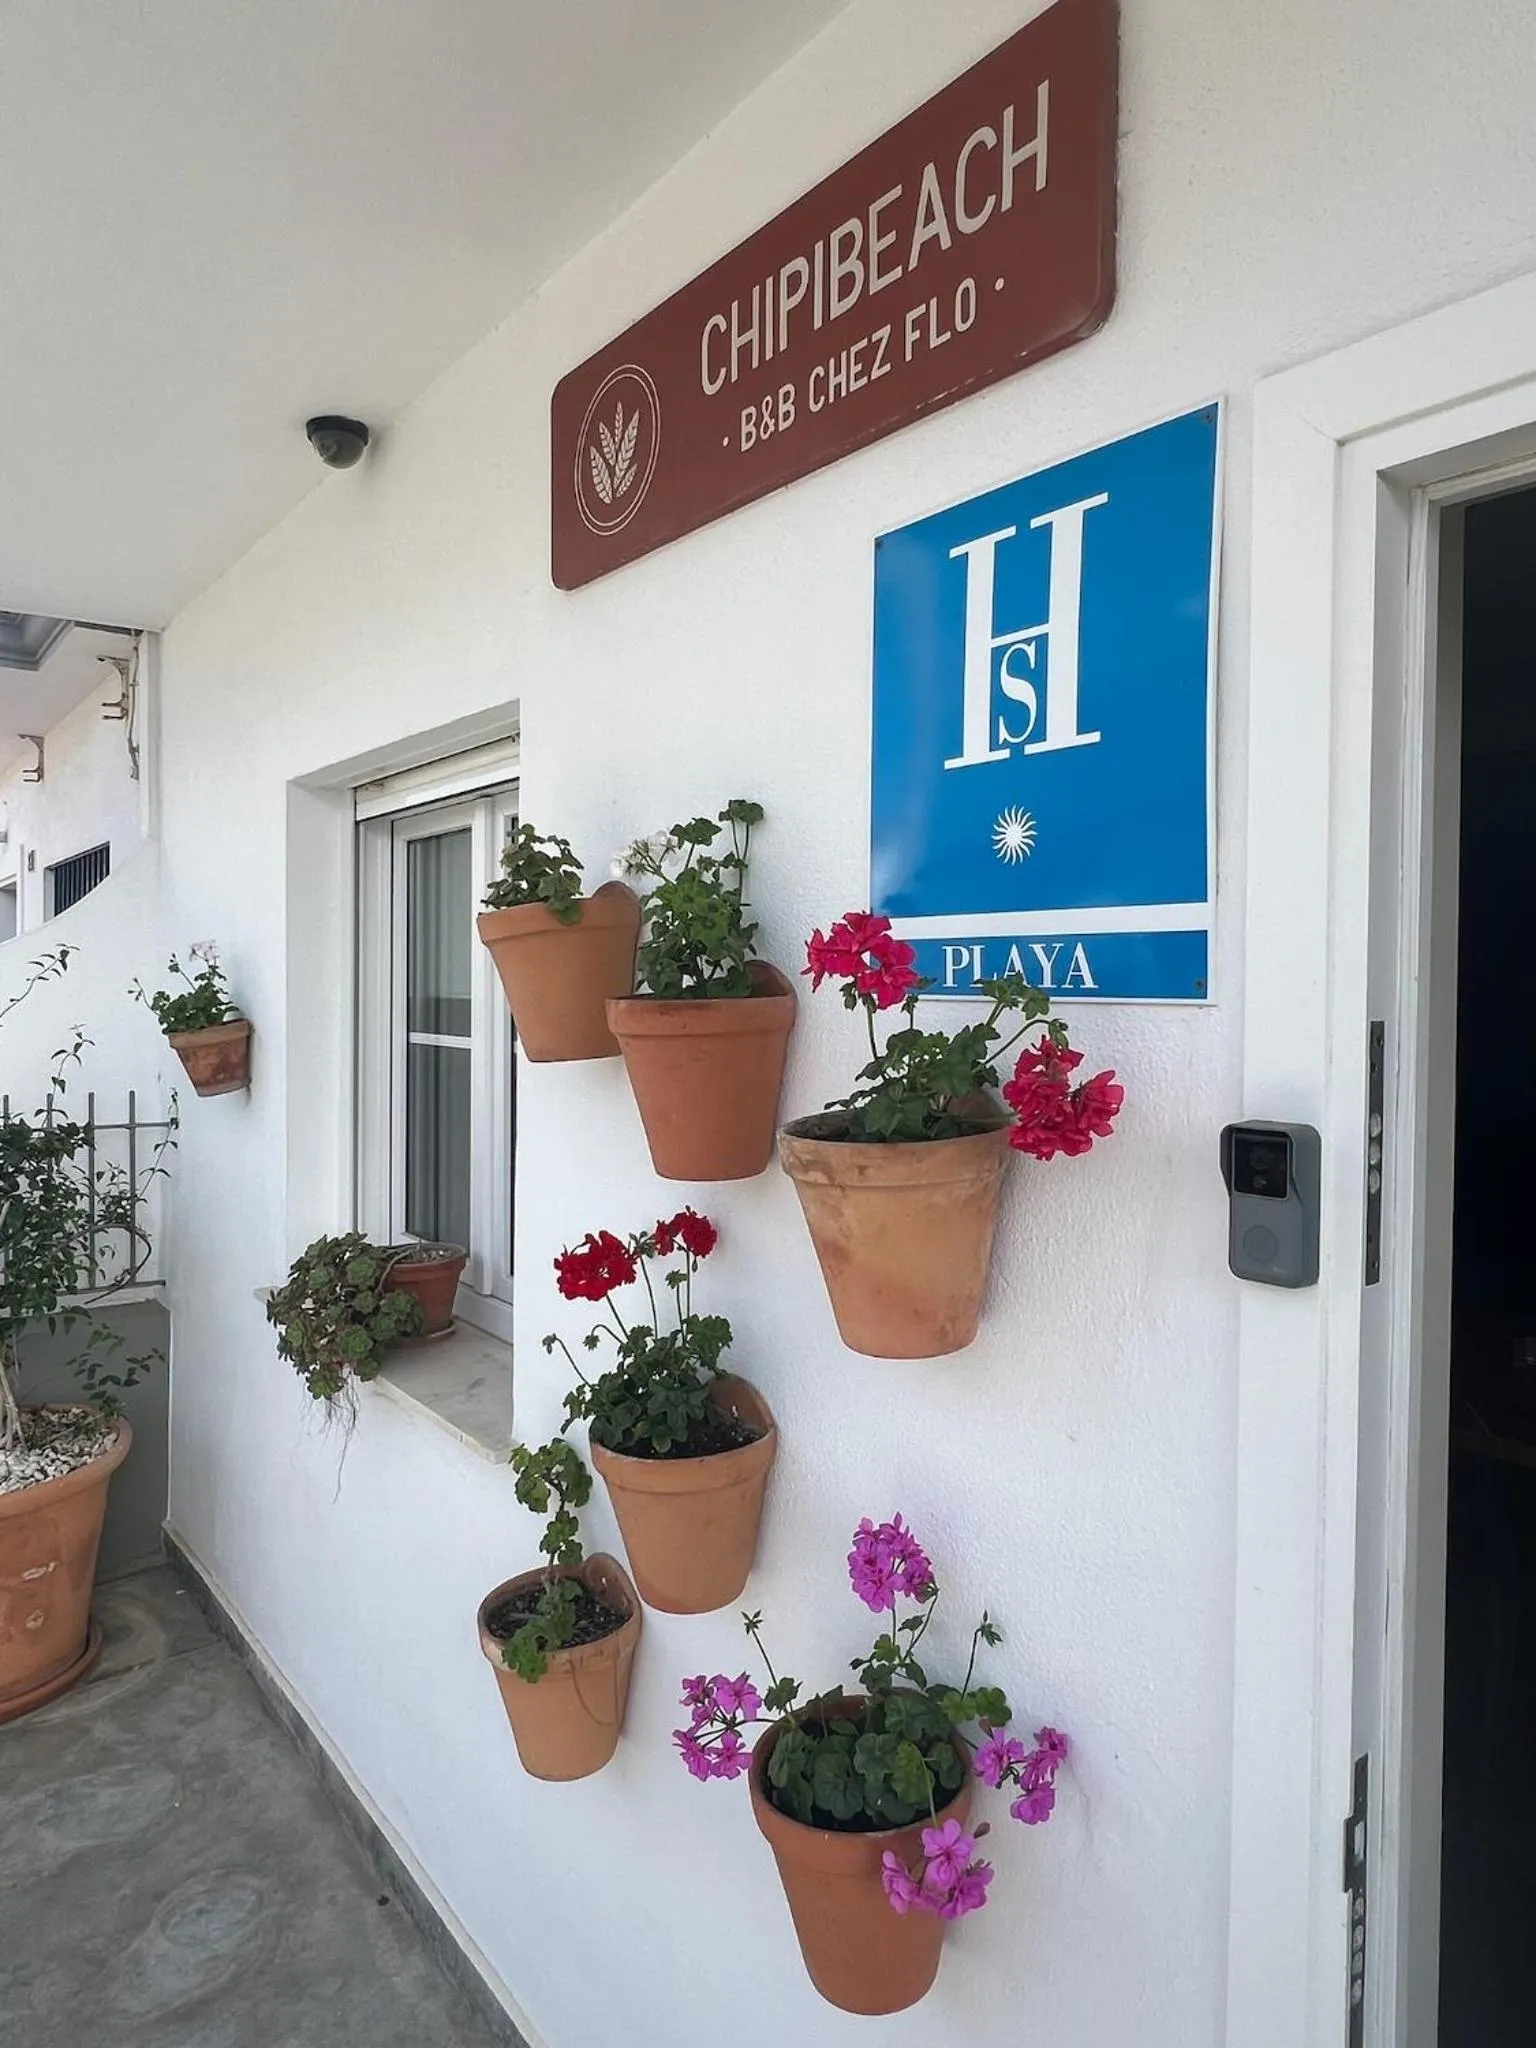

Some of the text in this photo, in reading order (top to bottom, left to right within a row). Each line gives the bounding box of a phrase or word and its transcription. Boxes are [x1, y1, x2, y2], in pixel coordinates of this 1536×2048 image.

[701, 79, 1049, 395] CHIPIBEACH
[740, 277, 976, 452] B&B CHEZ FLO
[942, 941, 1099, 989] PLAYA
